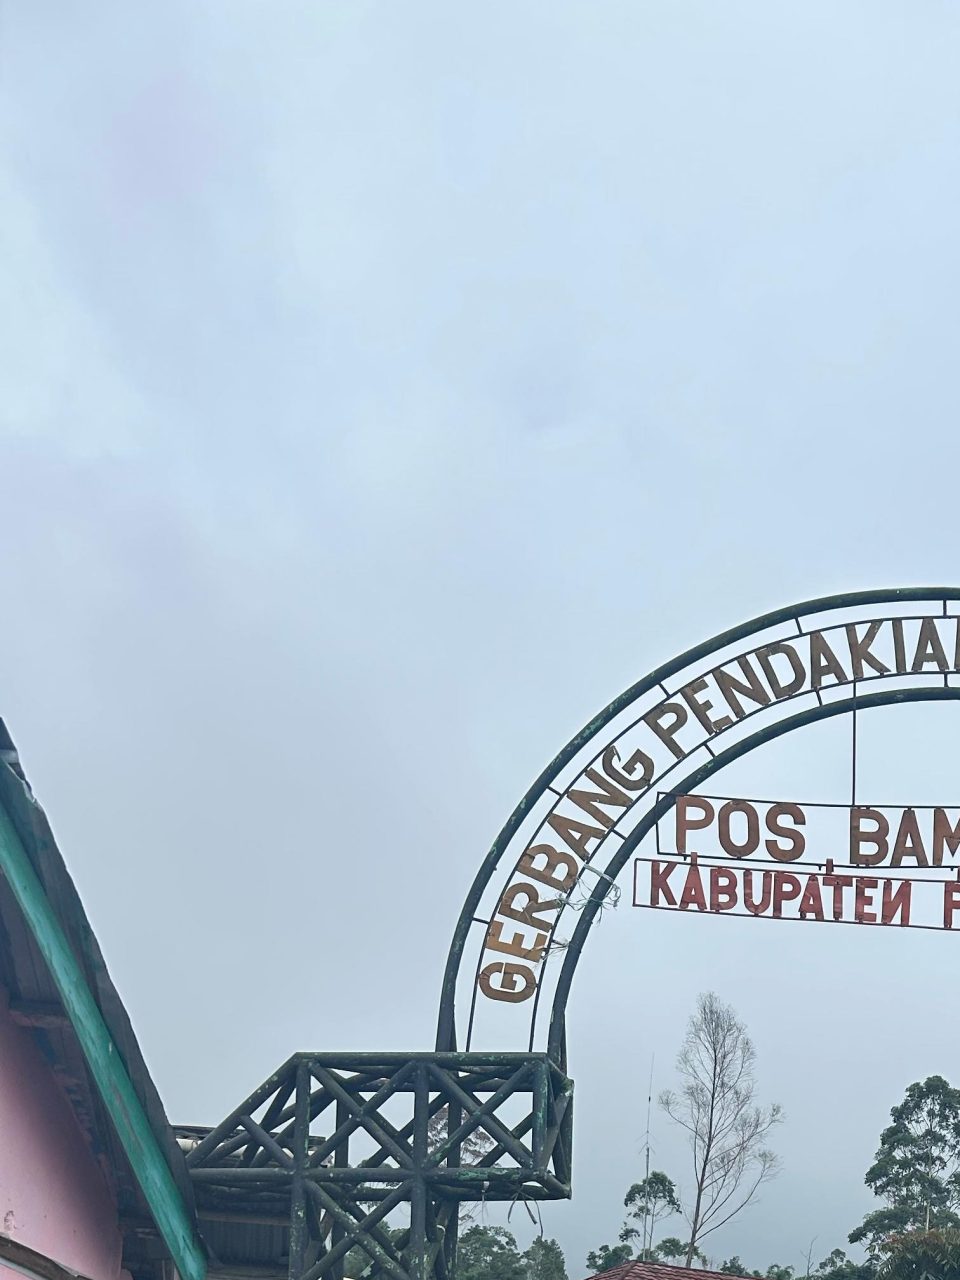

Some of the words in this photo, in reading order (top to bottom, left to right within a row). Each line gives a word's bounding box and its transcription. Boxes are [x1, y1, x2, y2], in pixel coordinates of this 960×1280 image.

[675, 796, 806, 862] POS
[477, 746, 655, 1004] GERBANG
[651, 859, 912, 927] KABUPATEN
